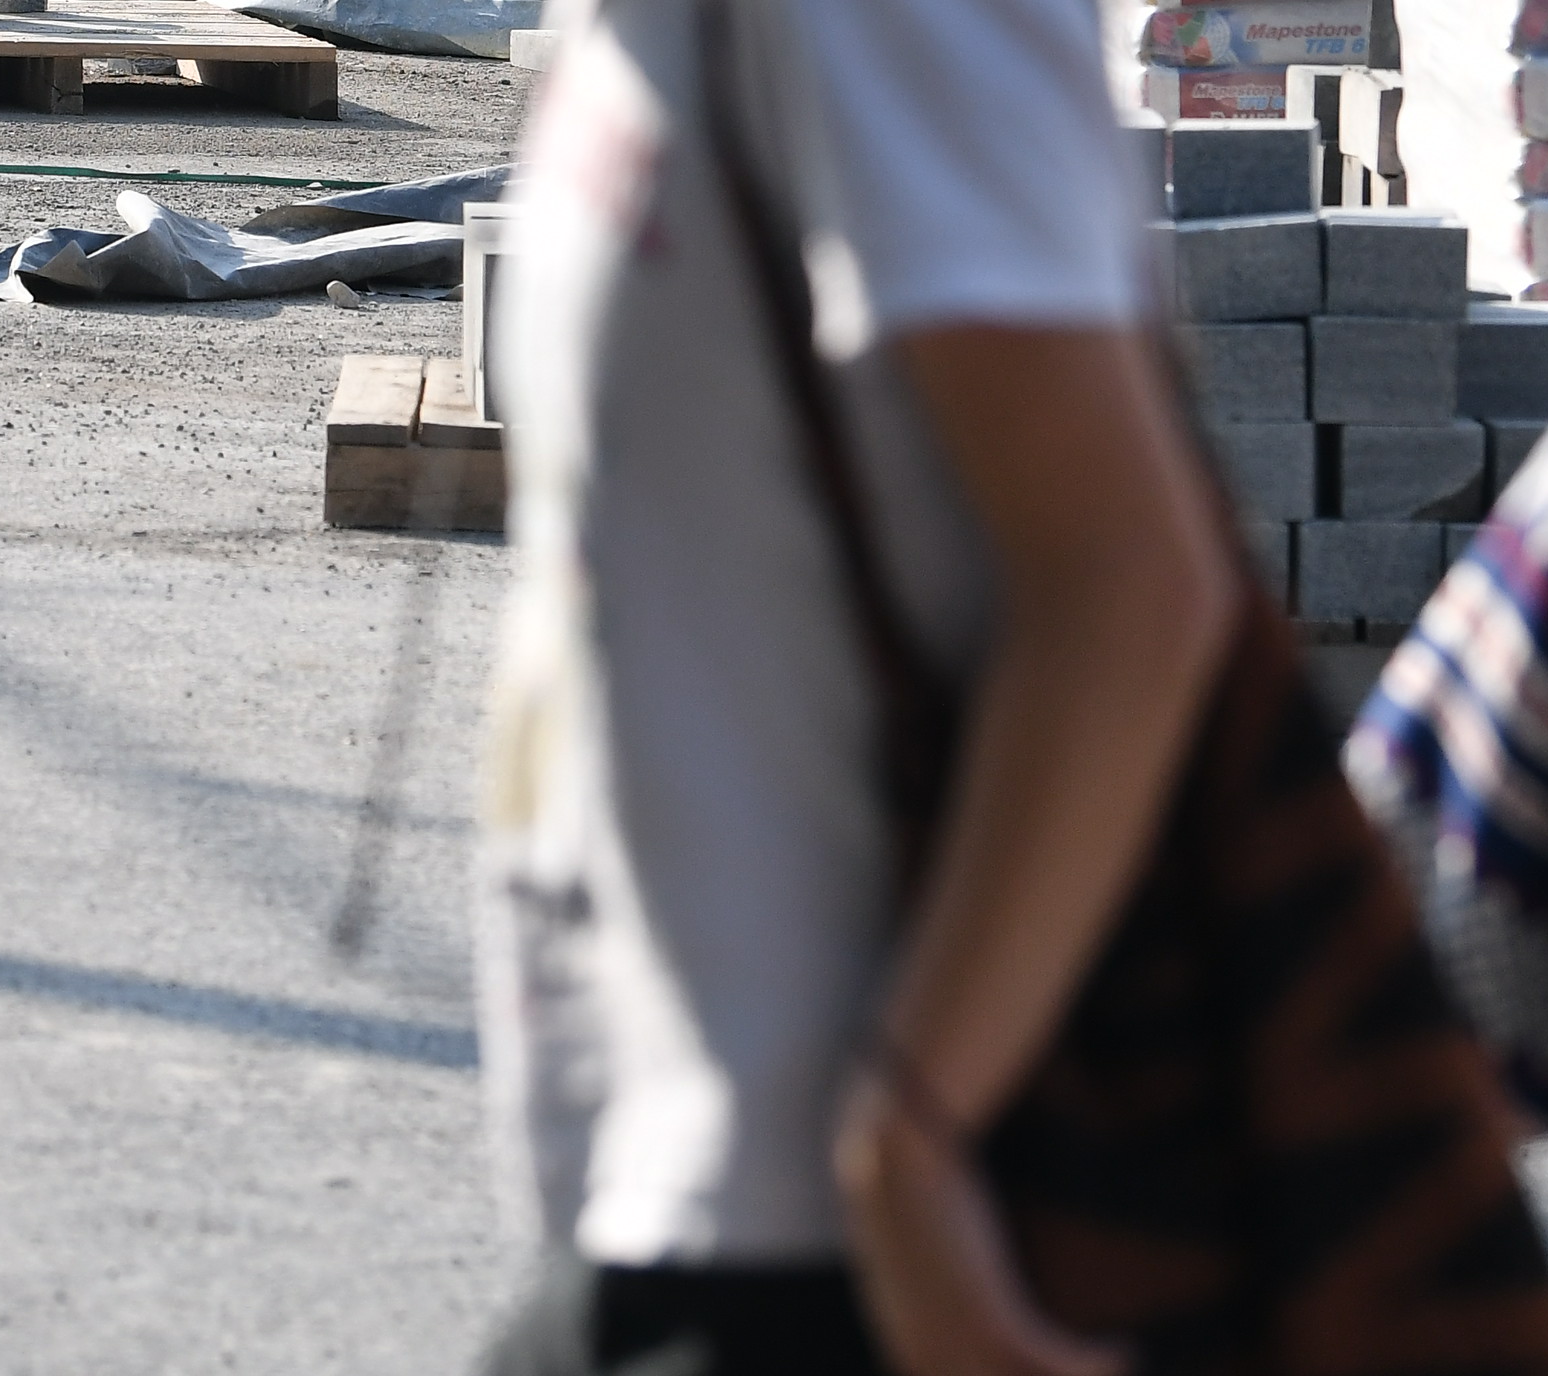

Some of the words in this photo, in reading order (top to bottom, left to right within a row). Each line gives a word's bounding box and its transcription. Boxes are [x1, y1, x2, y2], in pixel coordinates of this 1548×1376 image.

[1245, 23, 1362, 42] Mapestone
[1305, 38, 1345, 55] TFB
[1352, 38, 1369, 54] 6
